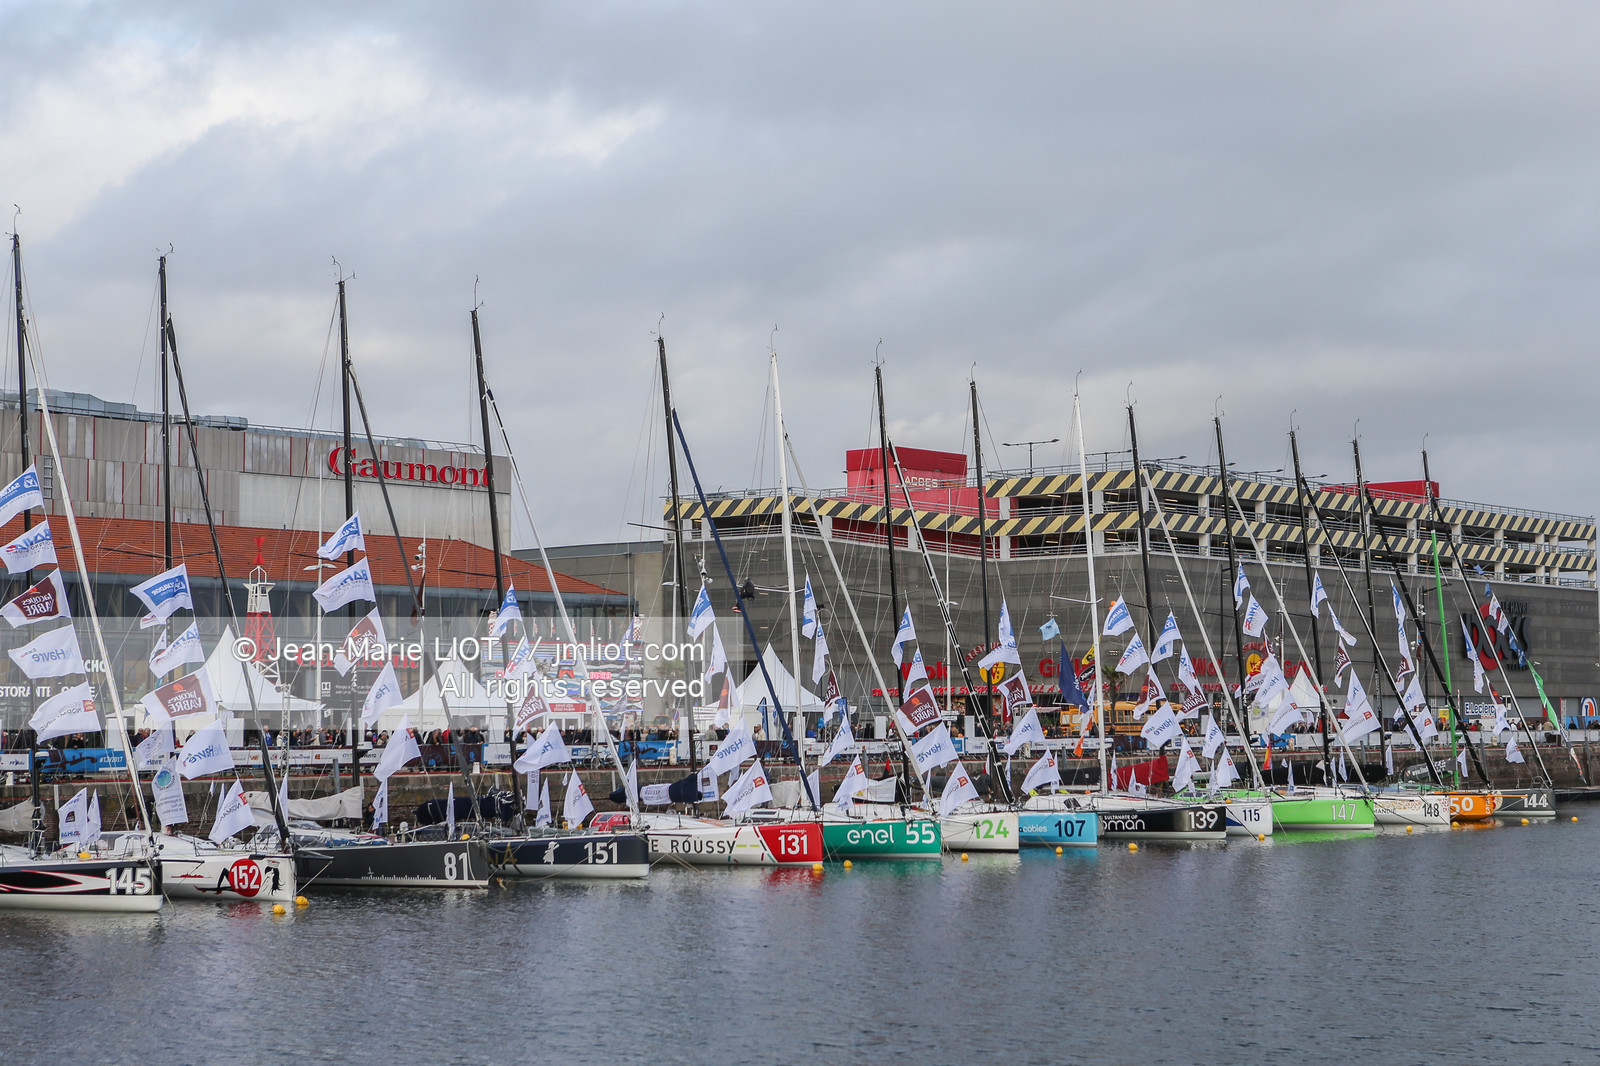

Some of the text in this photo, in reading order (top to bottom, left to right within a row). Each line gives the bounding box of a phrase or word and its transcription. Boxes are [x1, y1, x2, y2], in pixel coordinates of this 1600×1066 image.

[1422, 803, 1440, 818] 148
[1522, 793, 1549, 808] 144
[1188, 810, 1219, 830] 139
[1242, 808, 1261, 822] 115
[1331, 803, 1356, 821] 147
[847, 825, 895, 845] enel
[906, 823, 935, 845] 55
[974, 819, 1010, 839] 124
[1054, 819, 1086, 838] 107
[583, 841, 618, 865] 151
[670, 838, 736, 855] ROUSSY
[777, 834, 808, 856] 131
[231, 864, 261, 890] 152
[443, 852, 469, 882] 81
[105, 867, 153, 896] 145
